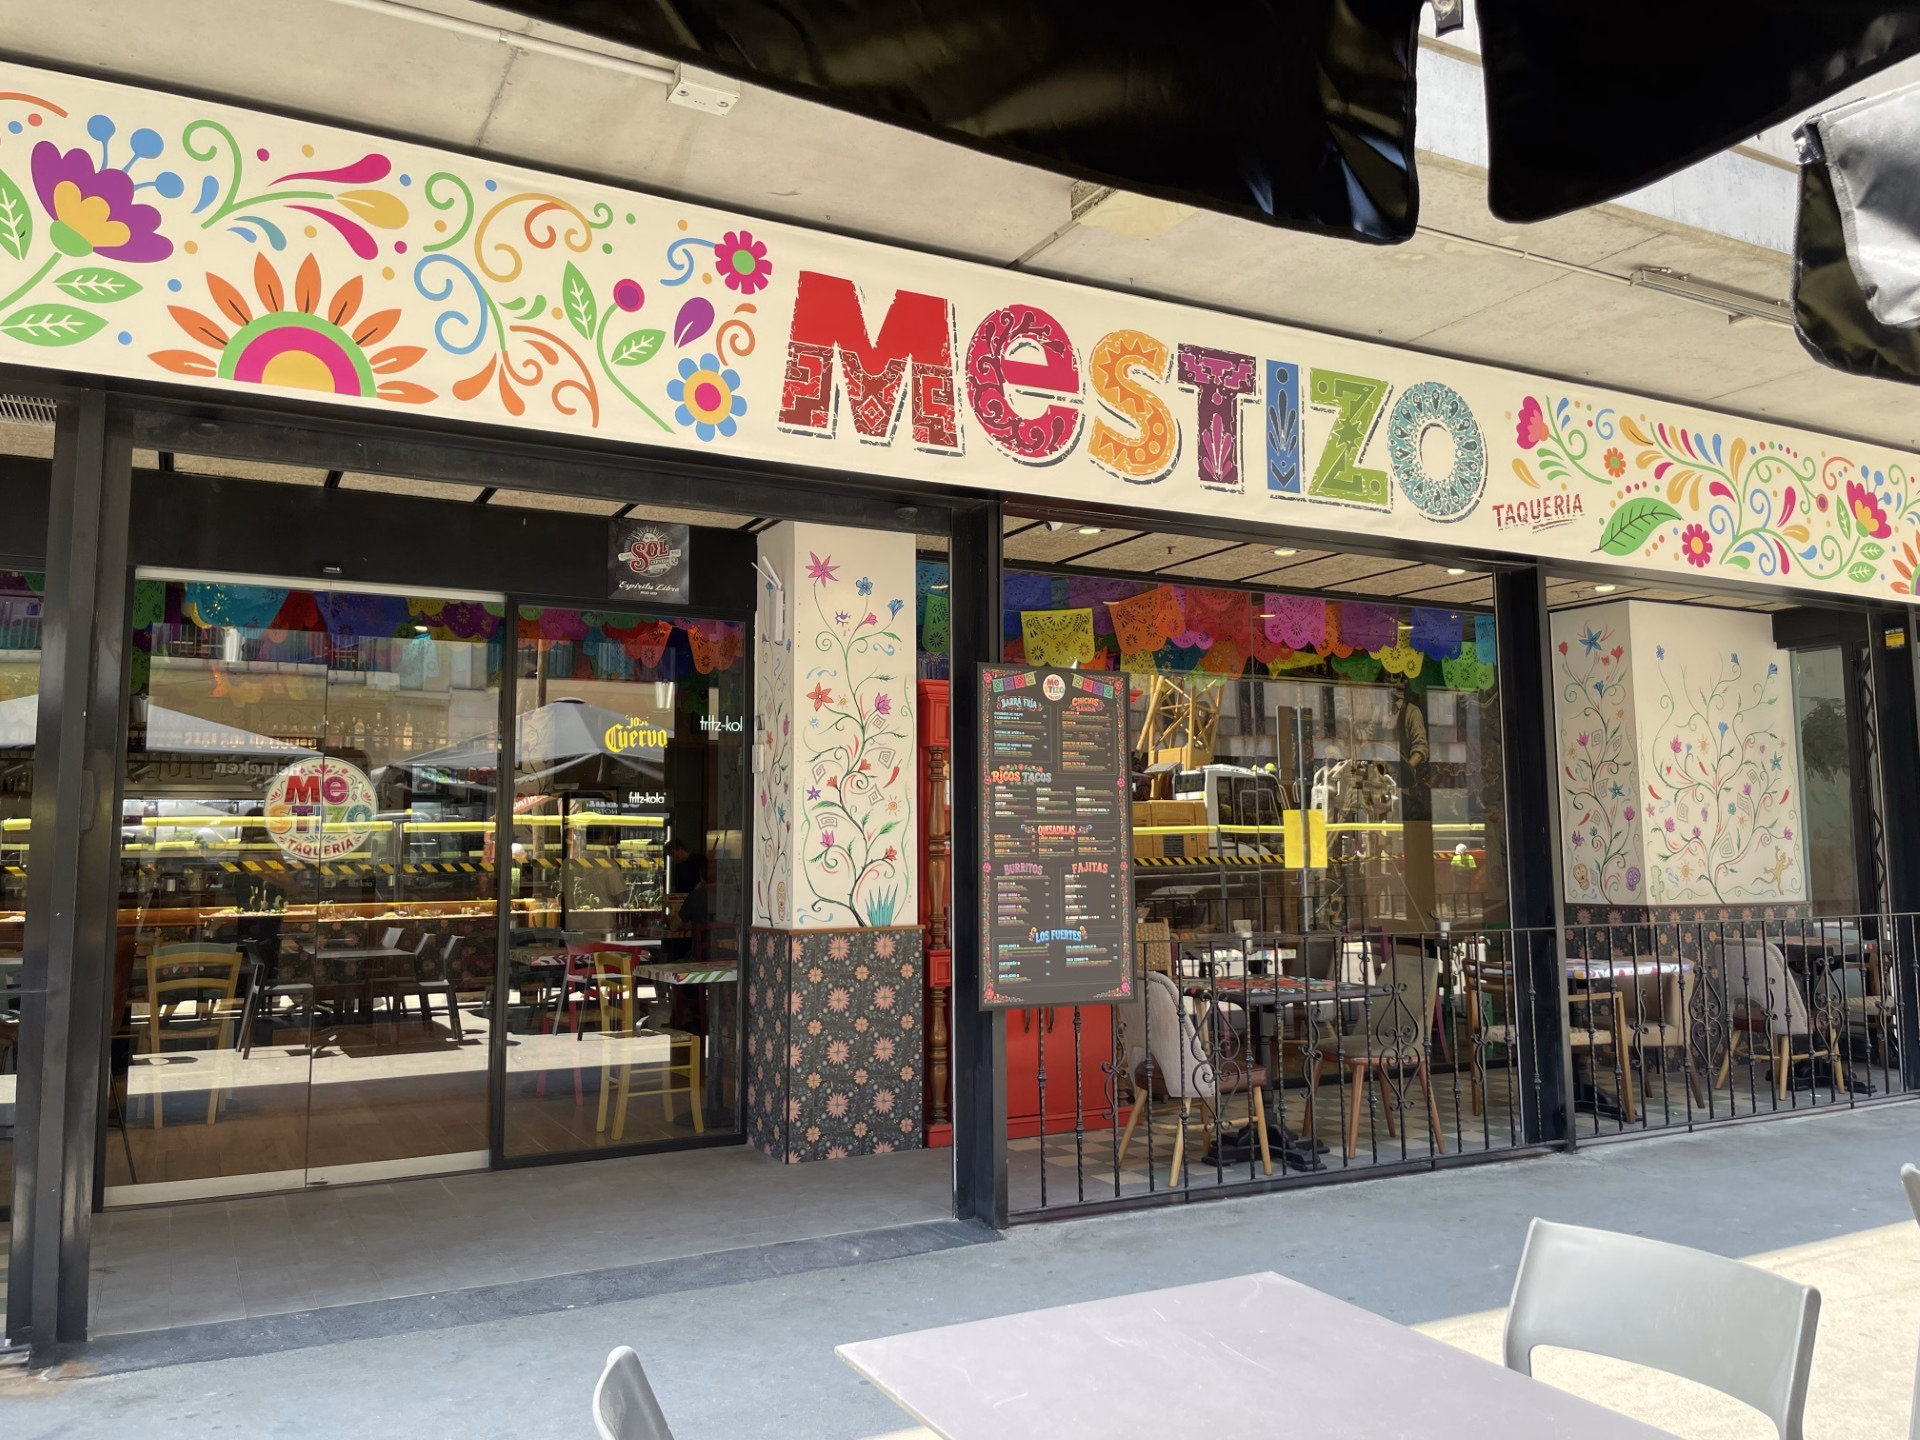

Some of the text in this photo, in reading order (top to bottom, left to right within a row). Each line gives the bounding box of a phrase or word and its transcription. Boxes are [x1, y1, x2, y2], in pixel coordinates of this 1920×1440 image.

[1492, 494, 1583, 528] TAQUERIA
[630, 540, 669, 573] SOL
[1001, 697, 1022, 708] BARRA
[700, 715, 743, 732] fritz-kol
[605, 723, 668, 753] Cuervo
[992, 770, 1053, 784] RICOS TACOS
[628, 791, 665, 804] fritz-kola
[1037, 824, 1077, 836] QUESADILLAS
[288, 838, 355, 856] TAQUERIA
[1003, 862, 1044, 876] BURRITOS
[1071, 861, 1109, 874] FAJITAS
[1035, 929, 1083, 944] LOS FUERTES
